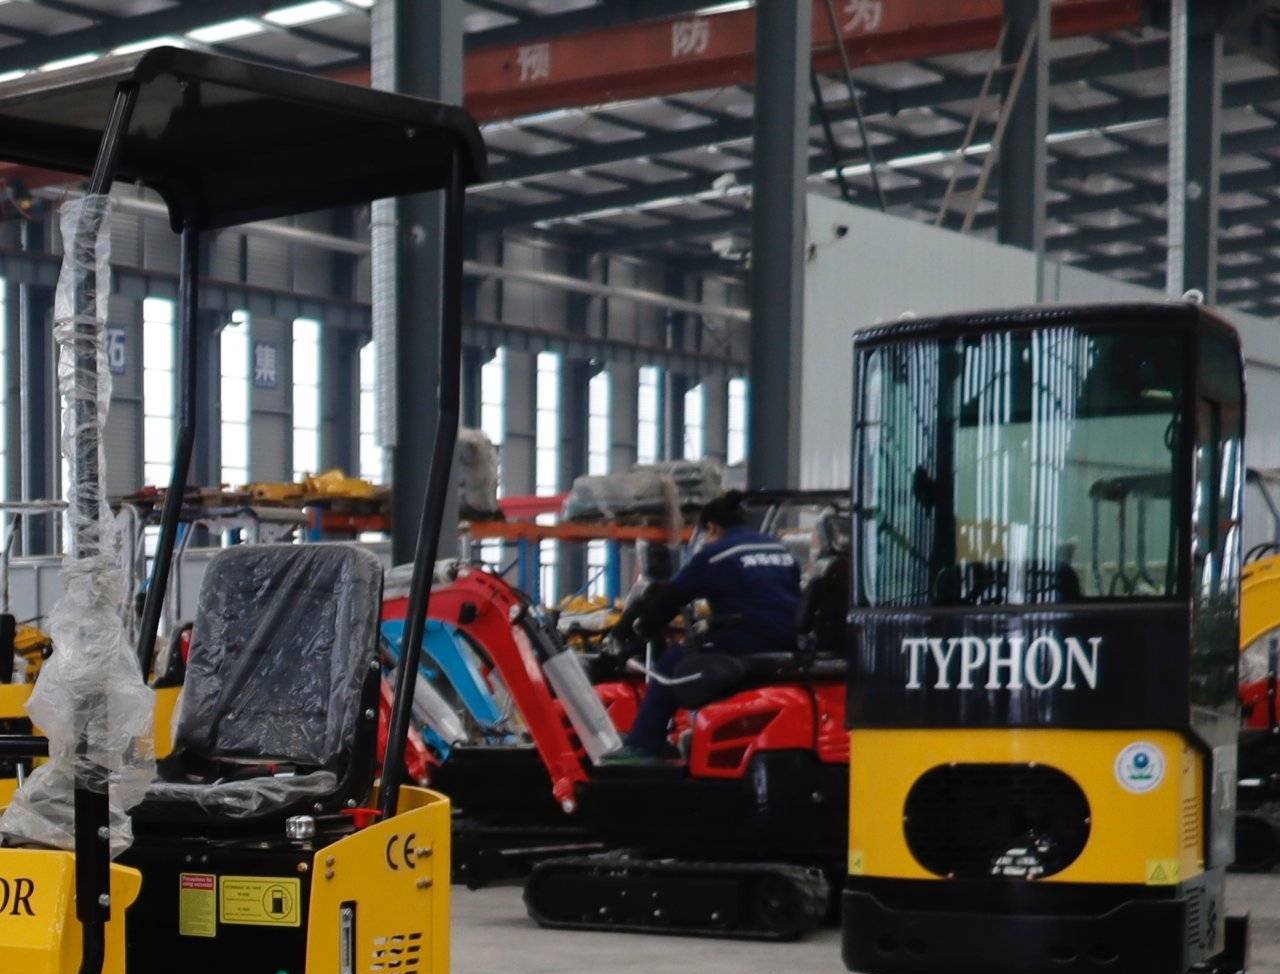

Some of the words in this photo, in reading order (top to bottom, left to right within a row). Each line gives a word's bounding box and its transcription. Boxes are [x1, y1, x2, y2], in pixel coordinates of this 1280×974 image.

[671, 19, 710, 58] 防
[901, 635, 1103, 691] TYPHON
[386, 832, 416, 871] CE
